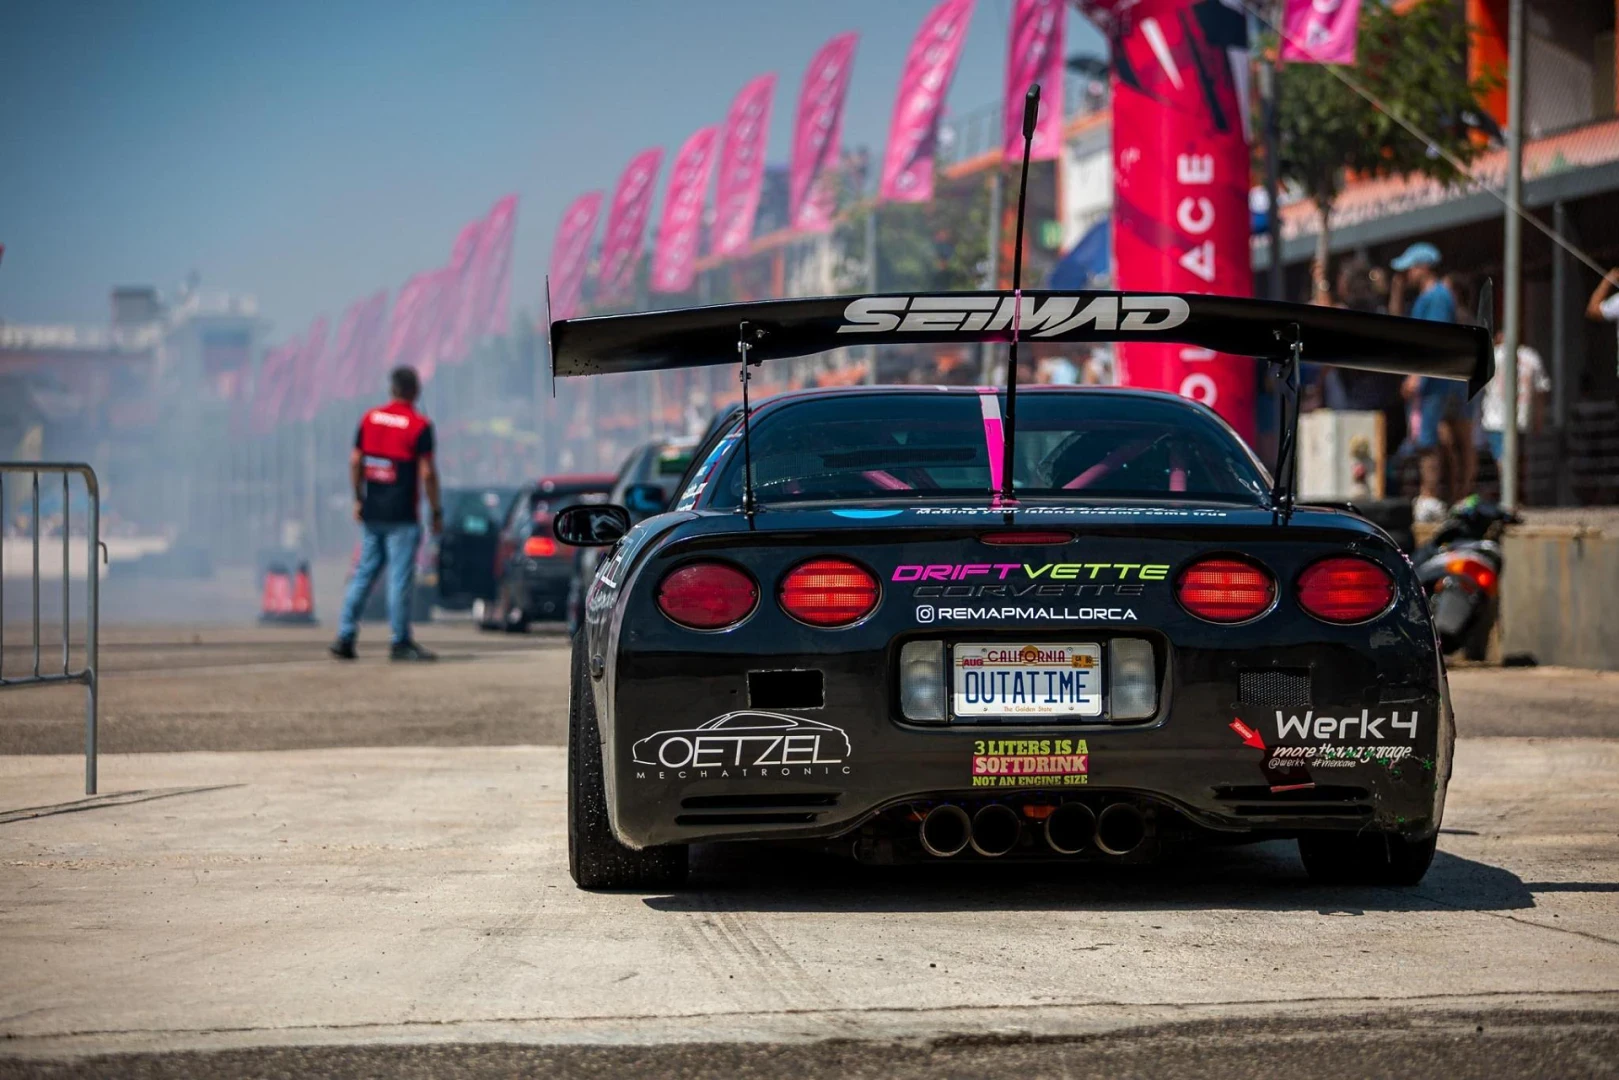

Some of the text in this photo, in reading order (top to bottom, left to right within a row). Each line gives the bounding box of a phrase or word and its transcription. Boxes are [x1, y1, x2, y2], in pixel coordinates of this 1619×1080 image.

[891, 564, 1170, 581] DRIFTVETTE
[913, 583, 1146, 598] CORVETTE
[938, 607, 1138, 620] REMAPMALLORCA
[963, 659, 984, 667] AUG
[987, 650, 1066, 663] CALIFORNIA
[965, 671, 1090, 704] OUTATIME
[658, 735, 842, 768] OETZEL
[973, 739, 1089, 755] 3 LITERS IS A
[1272, 746, 1316, 758] more
[975, 756, 1086, 774] SOFTDRINK
[636, 766, 851, 779] MECHATRONIC
[972, 774, 1088, 786] NOT AN ENGINE SIZE
